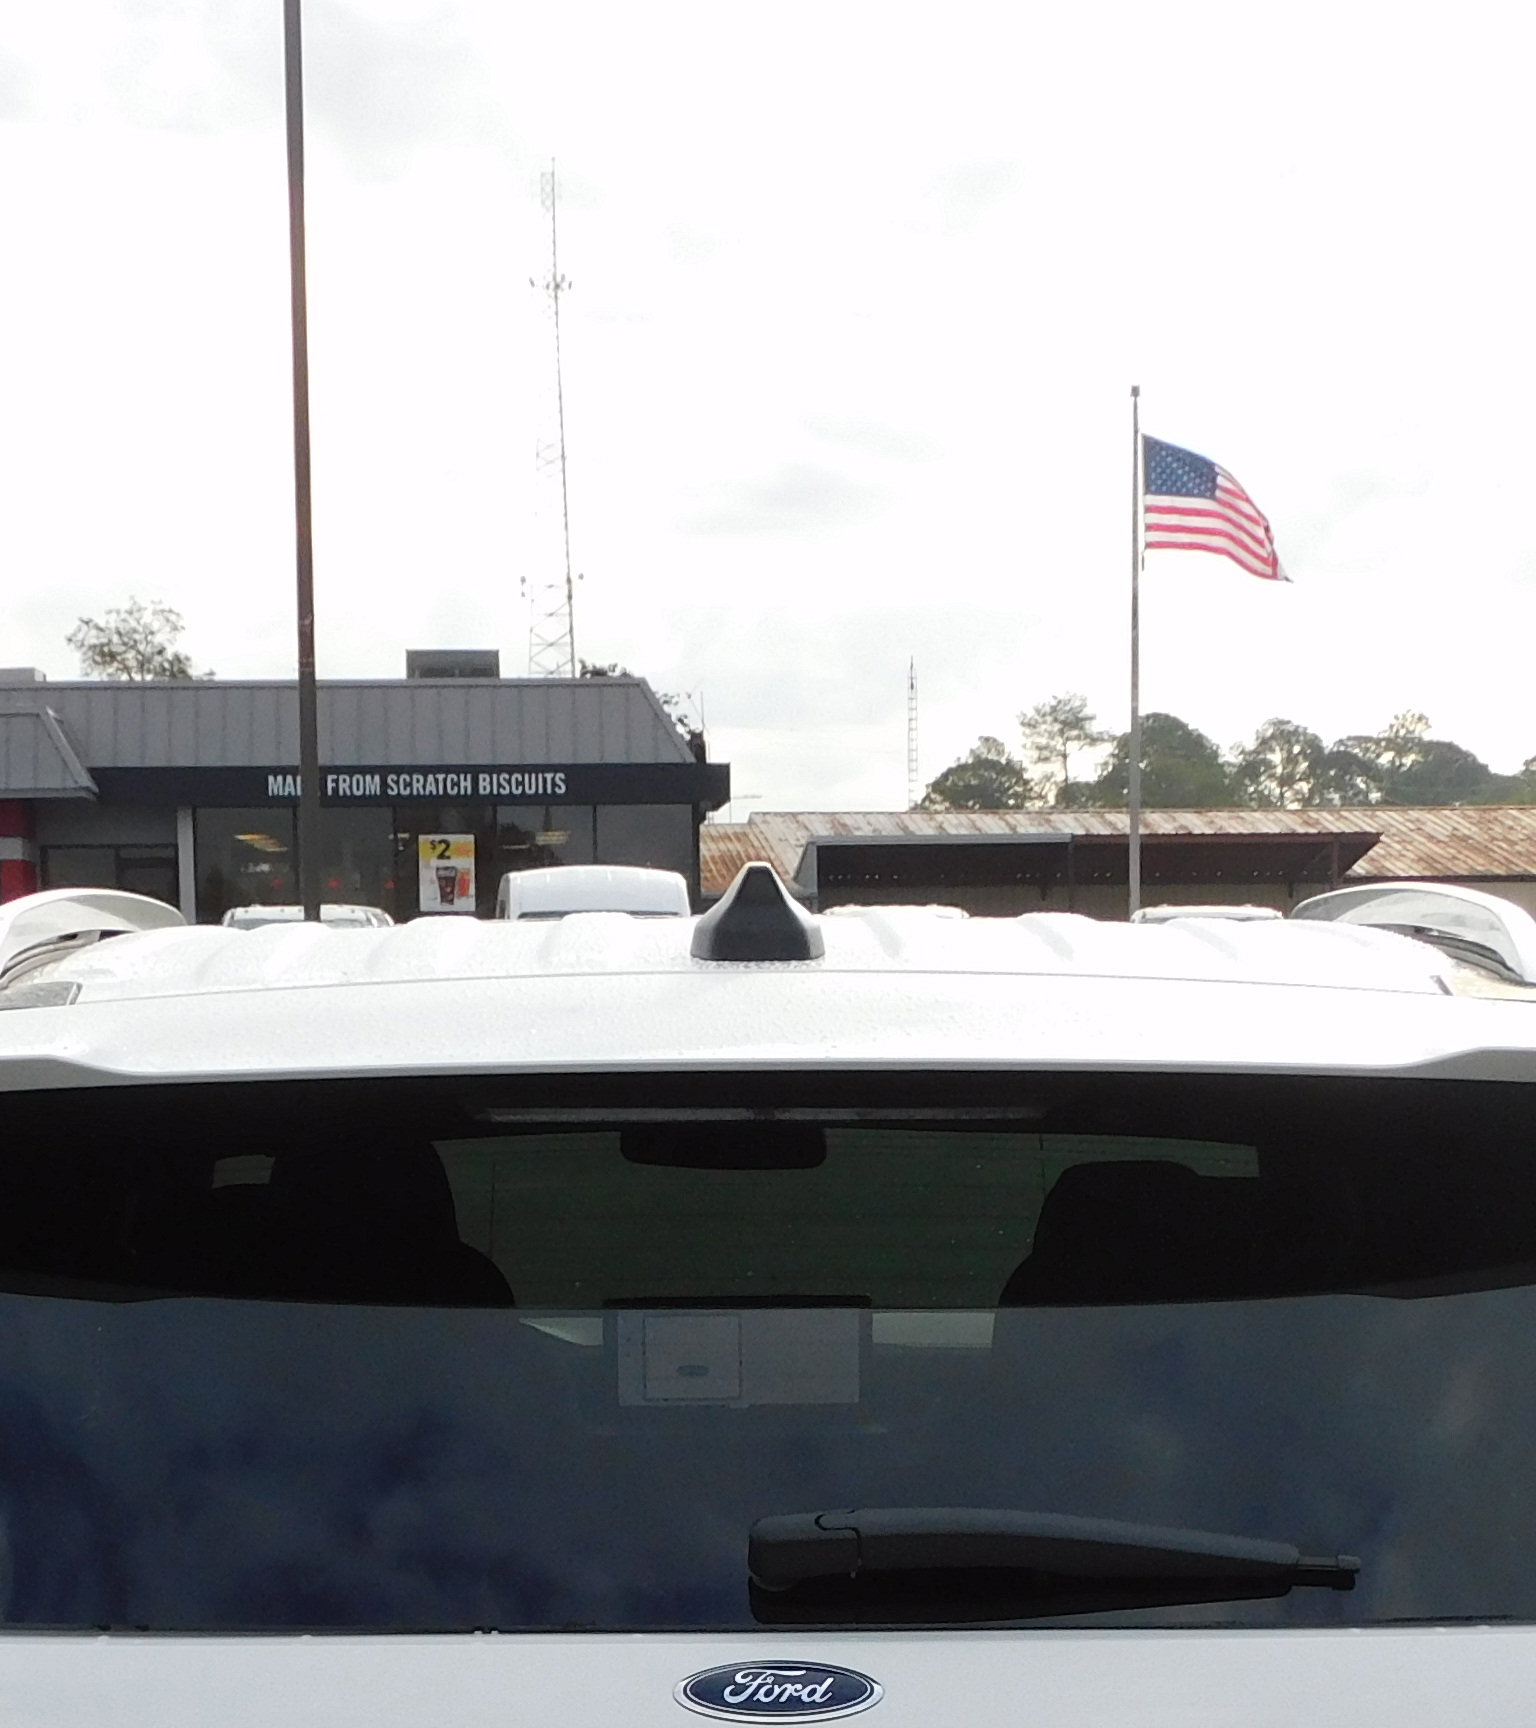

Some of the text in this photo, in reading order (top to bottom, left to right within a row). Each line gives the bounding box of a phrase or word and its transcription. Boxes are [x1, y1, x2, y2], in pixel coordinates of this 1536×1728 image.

[326, 774, 381, 796] FROM
[386, 773, 472, 796] SCRATCH
[478, 772, 567, 794] BISCUITS
[723, 1668, 834, 1704] Ford
